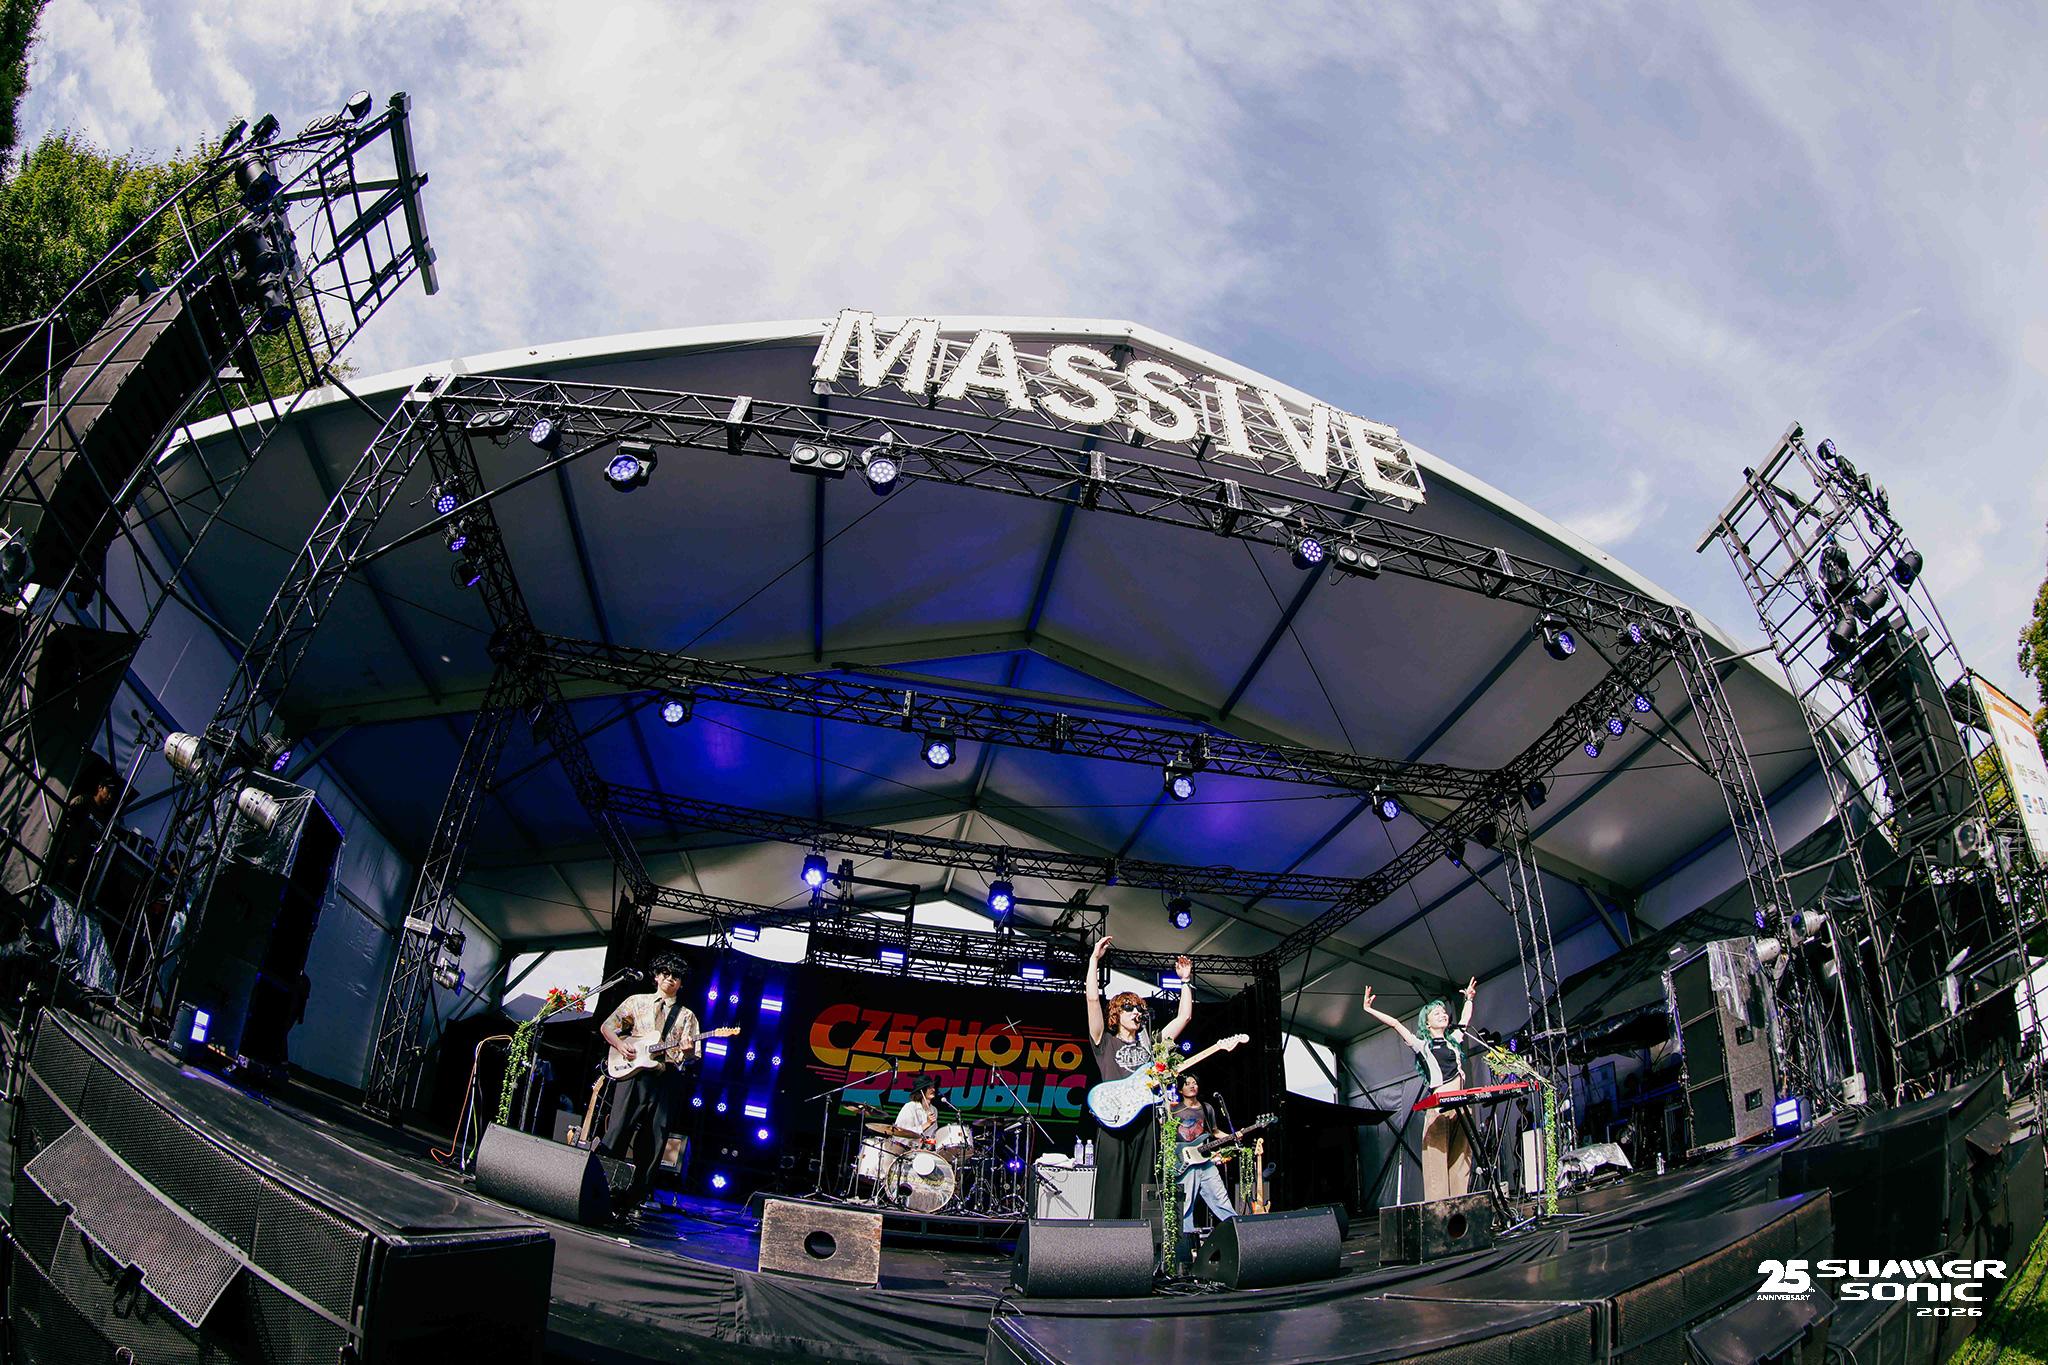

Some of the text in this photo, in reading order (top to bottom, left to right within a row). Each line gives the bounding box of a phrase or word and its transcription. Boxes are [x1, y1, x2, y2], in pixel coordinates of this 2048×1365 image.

[813, 307, 1427, 507] MASSIVE
[809, 1003, 1083, 1072] CZECHO NO
